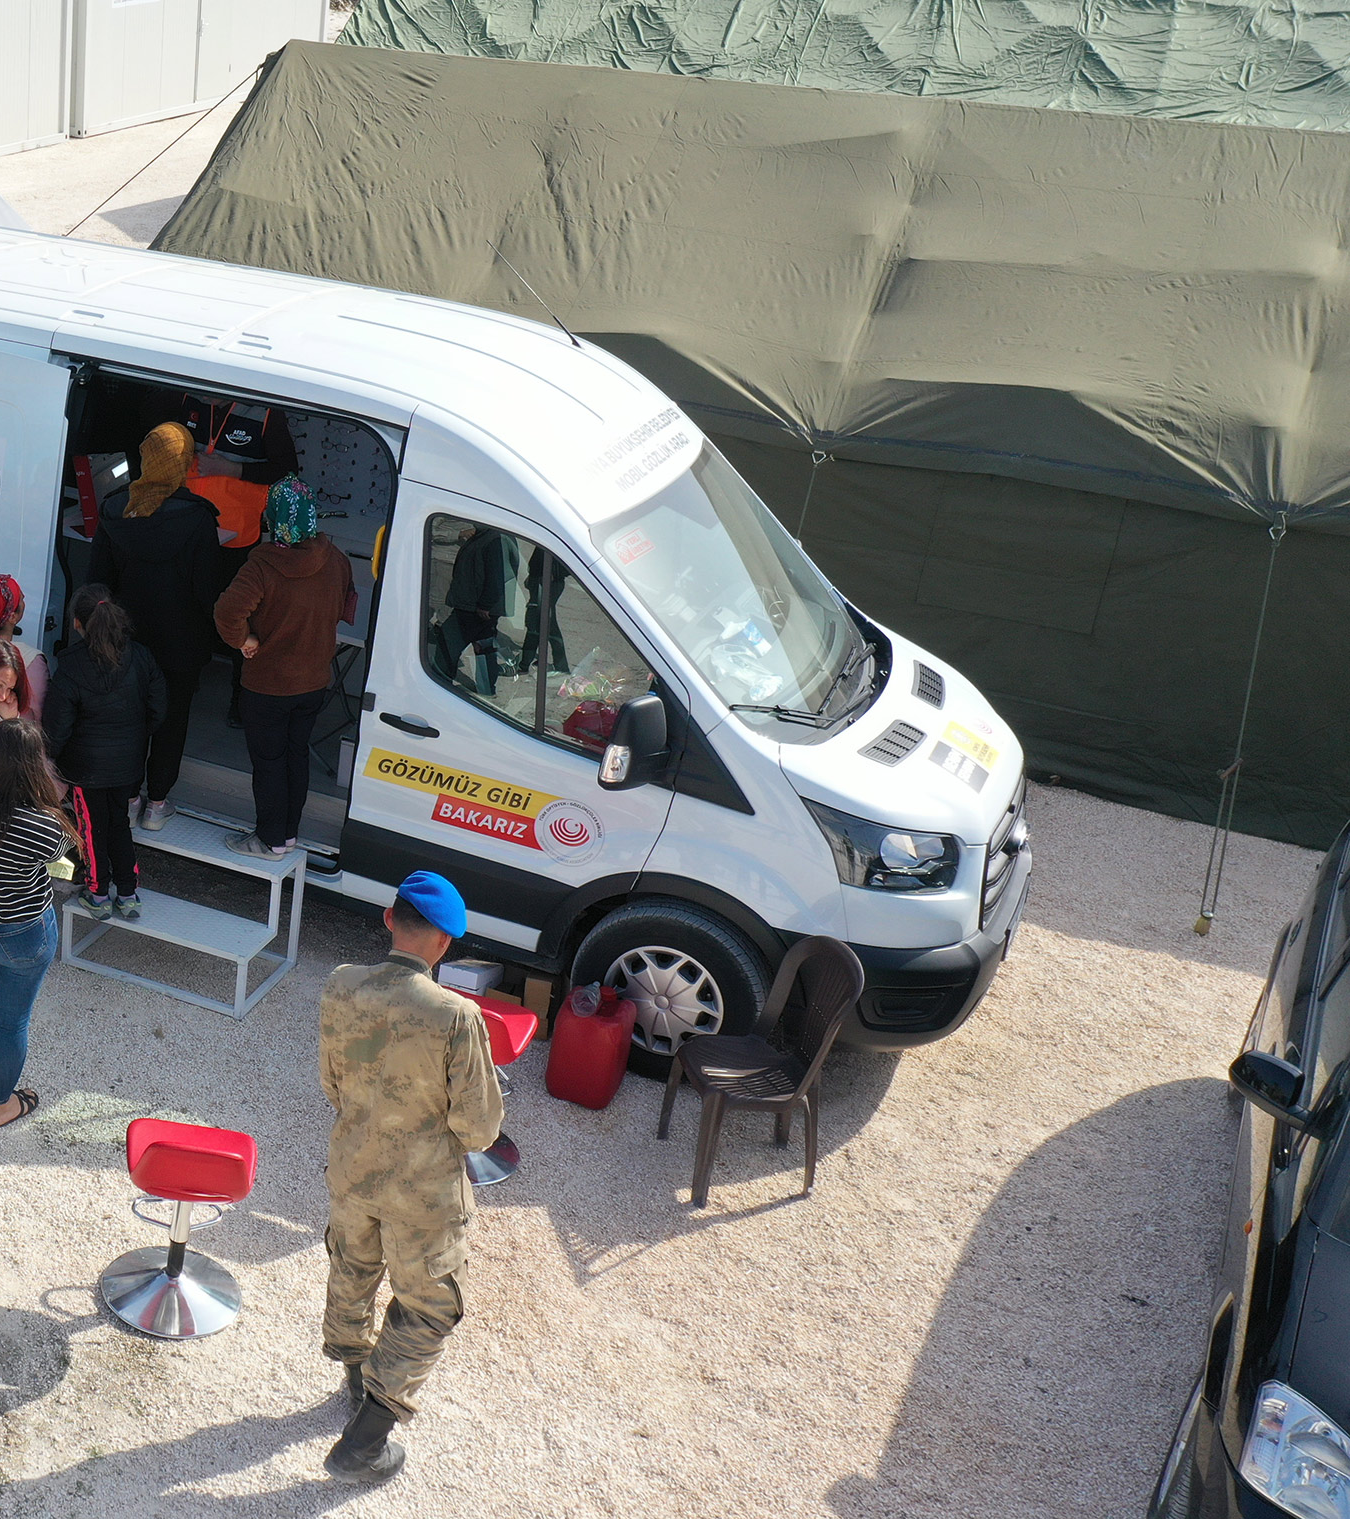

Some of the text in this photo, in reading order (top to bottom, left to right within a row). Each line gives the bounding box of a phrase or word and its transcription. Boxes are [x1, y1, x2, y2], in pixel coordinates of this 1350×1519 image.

[377, 757, 533, 811] GÖZÜMÜZ GİBİ
[438, 802, 528, 839] BAKARIZ
